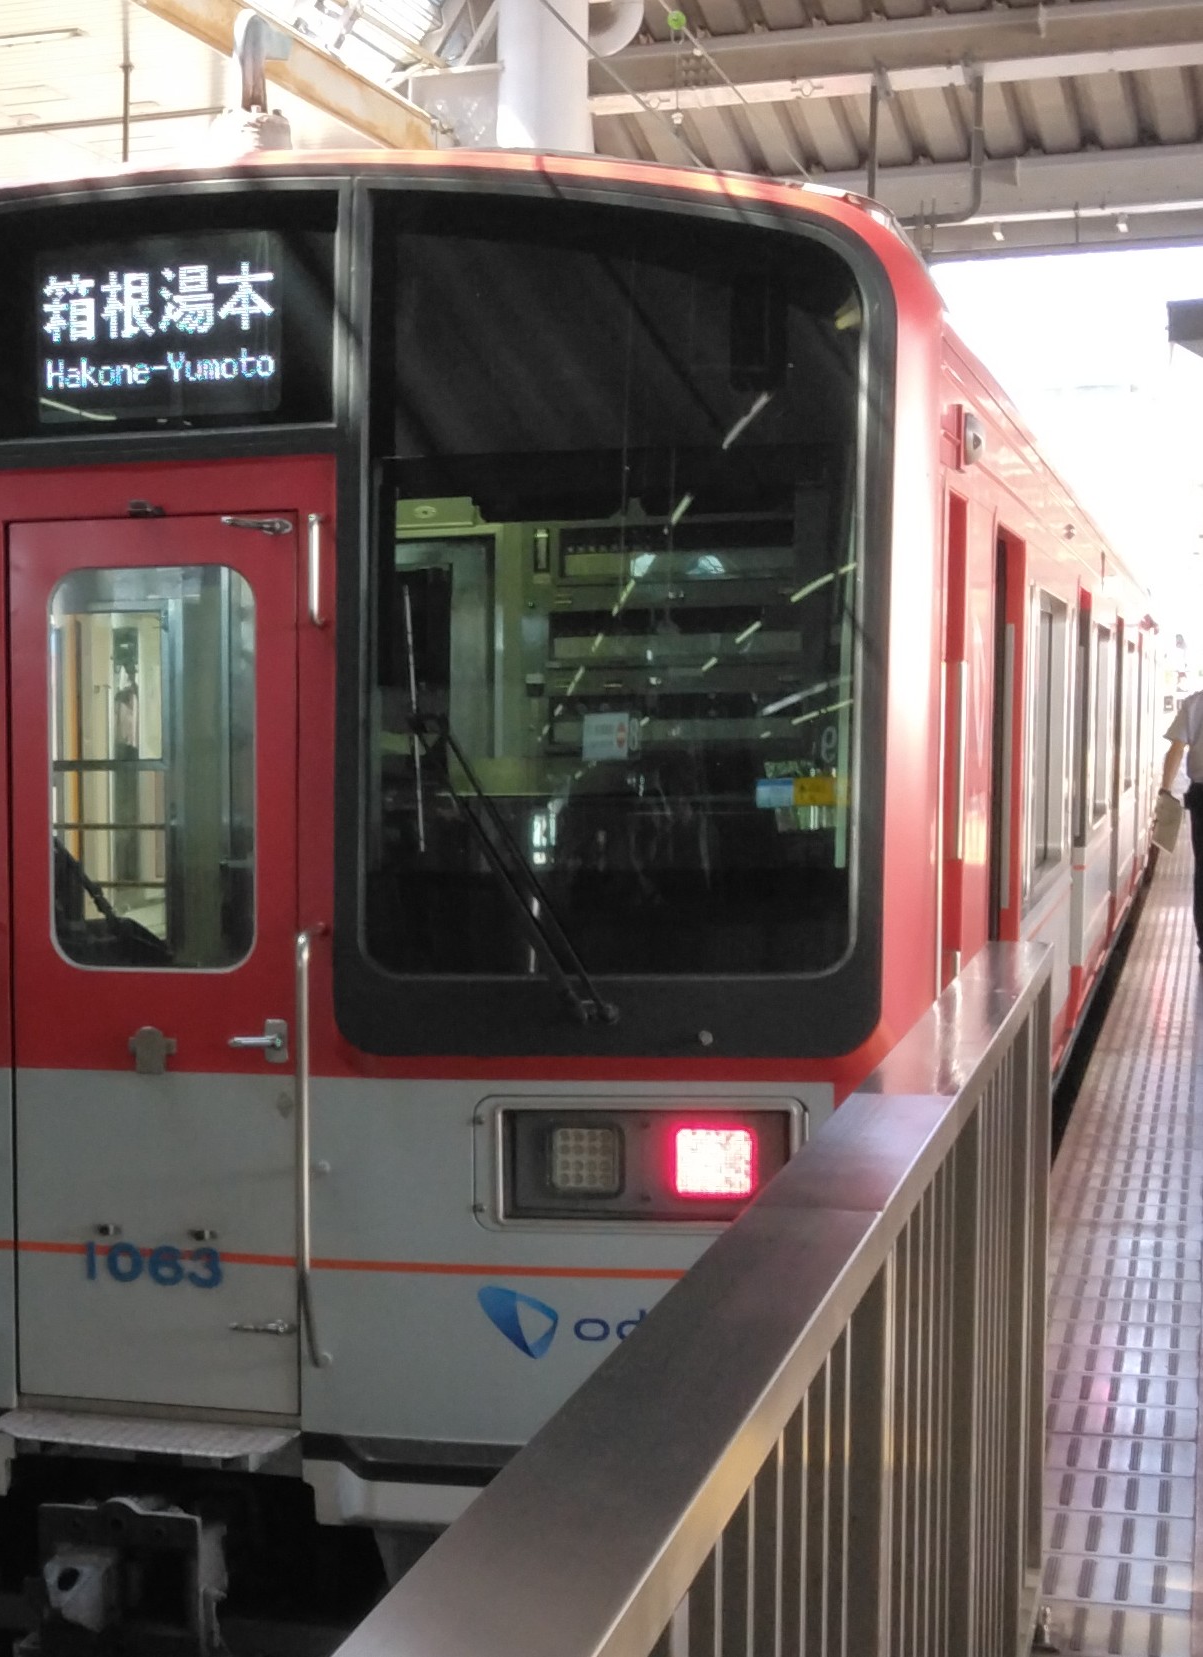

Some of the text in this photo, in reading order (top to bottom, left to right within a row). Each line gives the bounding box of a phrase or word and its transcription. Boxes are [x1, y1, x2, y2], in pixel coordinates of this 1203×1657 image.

[43, 261, 275, 343] 箱根湯本
[45, 348, 275, 390] Hakone-Yumoto
[86, 1241, 223, 1289] 1063
